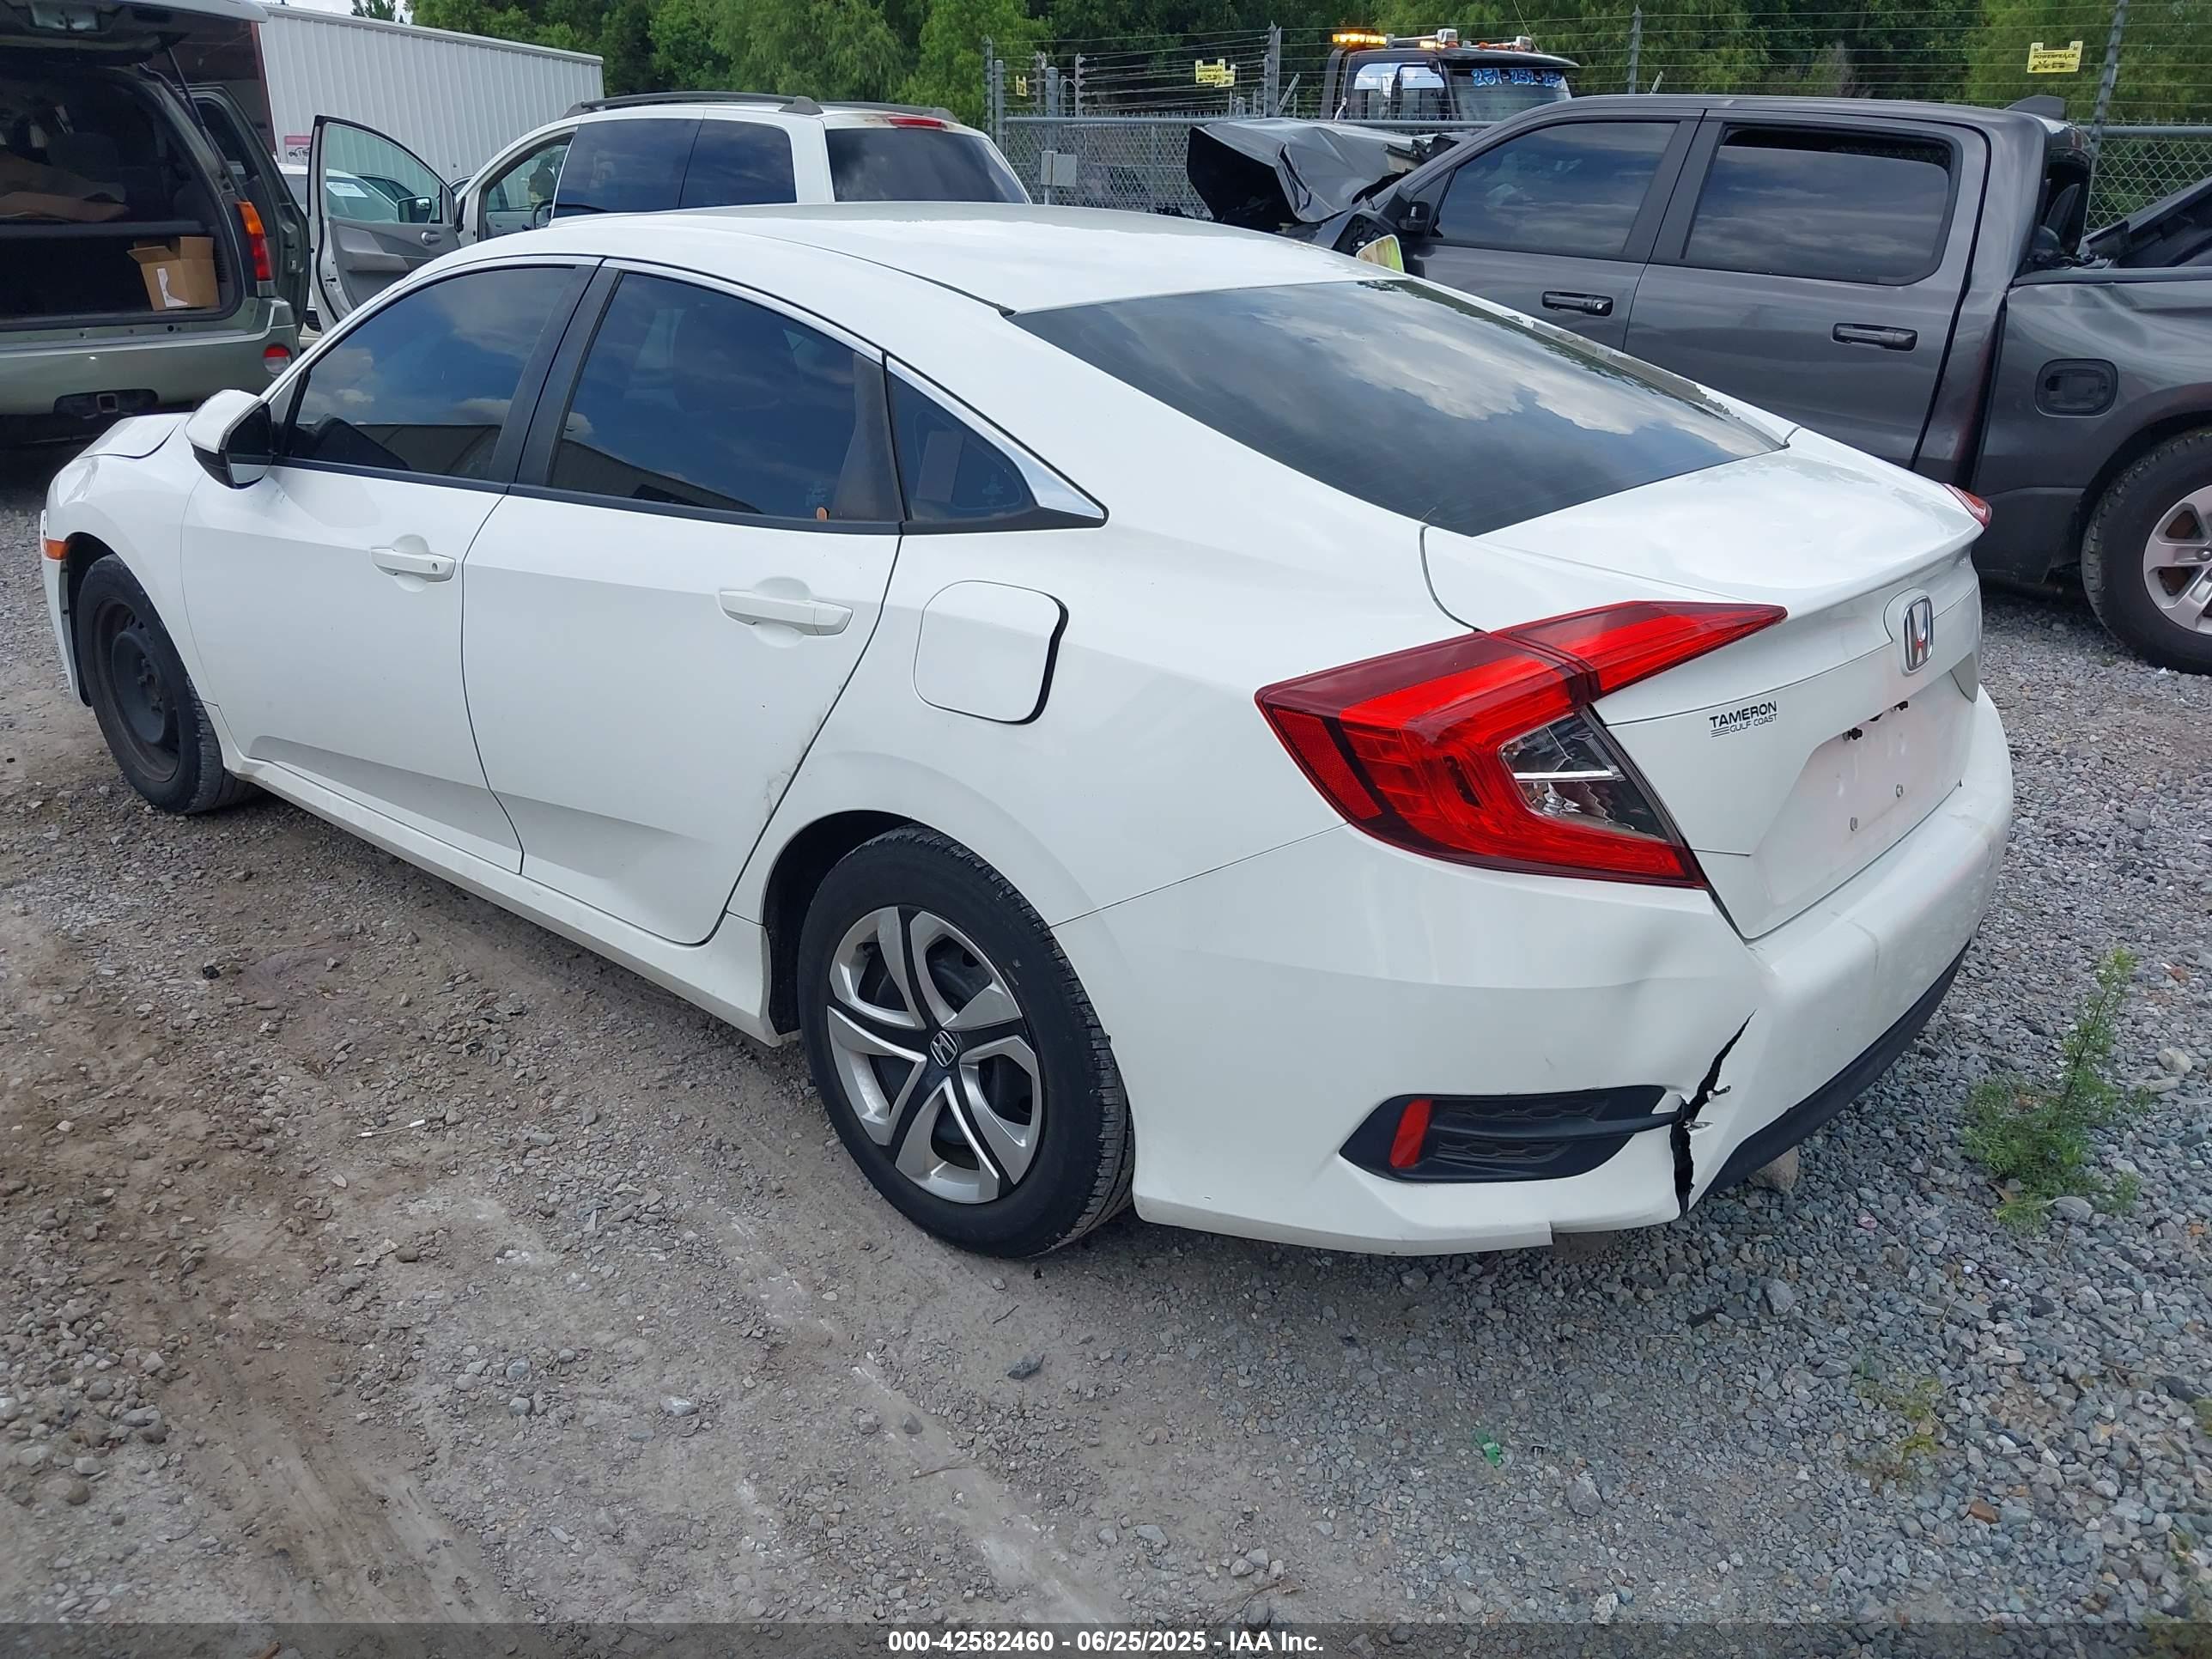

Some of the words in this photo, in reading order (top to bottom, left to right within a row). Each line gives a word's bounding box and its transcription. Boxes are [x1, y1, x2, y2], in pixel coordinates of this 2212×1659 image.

[1709, 700, 1778, 729] TAMERON
[1729, 720, 1752, 732] GULF
[1753, 713, 1778, 726] COAST
